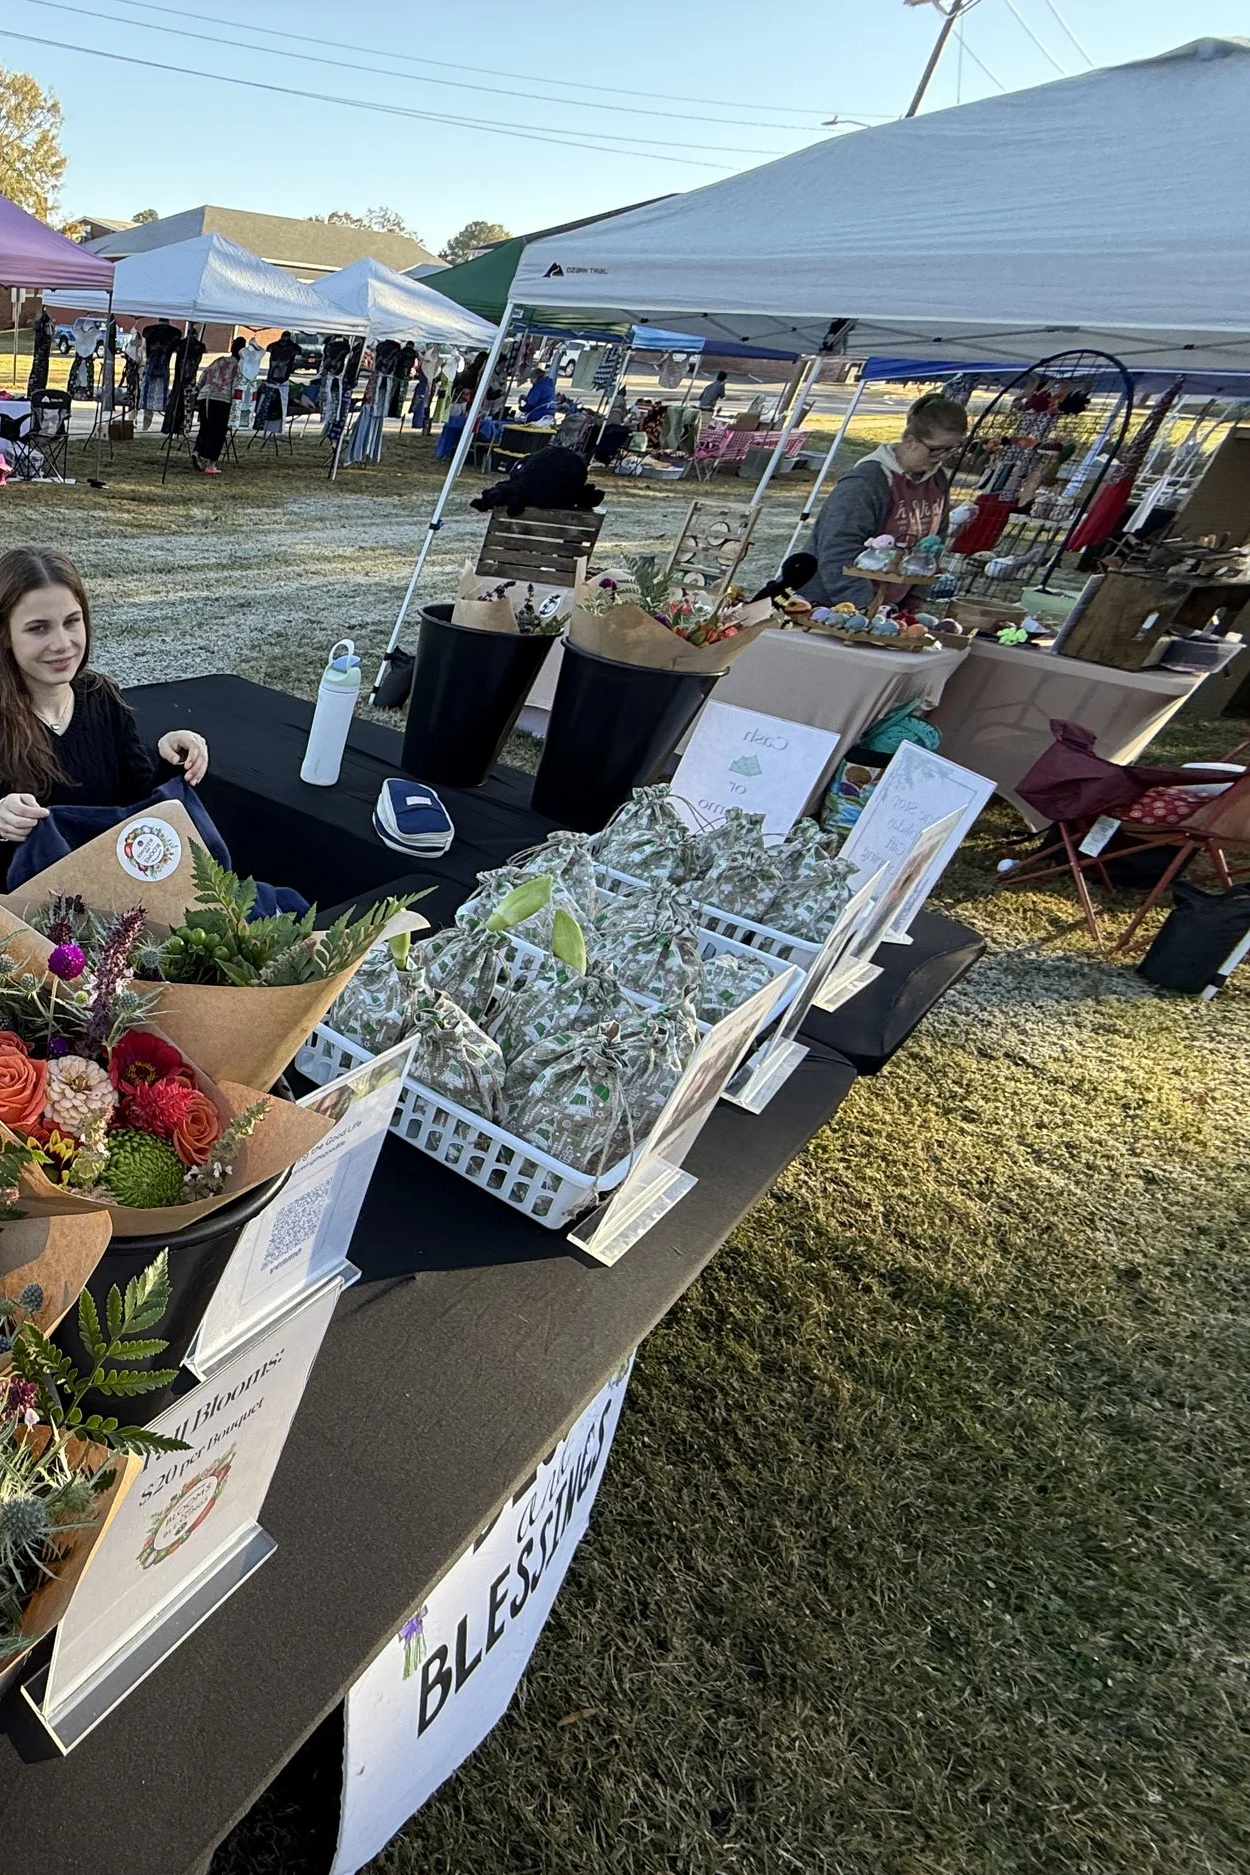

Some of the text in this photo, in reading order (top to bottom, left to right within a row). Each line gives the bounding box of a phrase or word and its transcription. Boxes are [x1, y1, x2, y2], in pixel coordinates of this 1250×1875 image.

[191, 1348, 285, 1433] Blooms:
[138, 1464, 178, 1507] $20
[179, 1446, 207, 1478] per
[206, 1397, 266, 1451] Bouquet
[165, 1482, 212, 1527] BLOOMS
[417, 1399, 612, 1738] BLESSINGS
